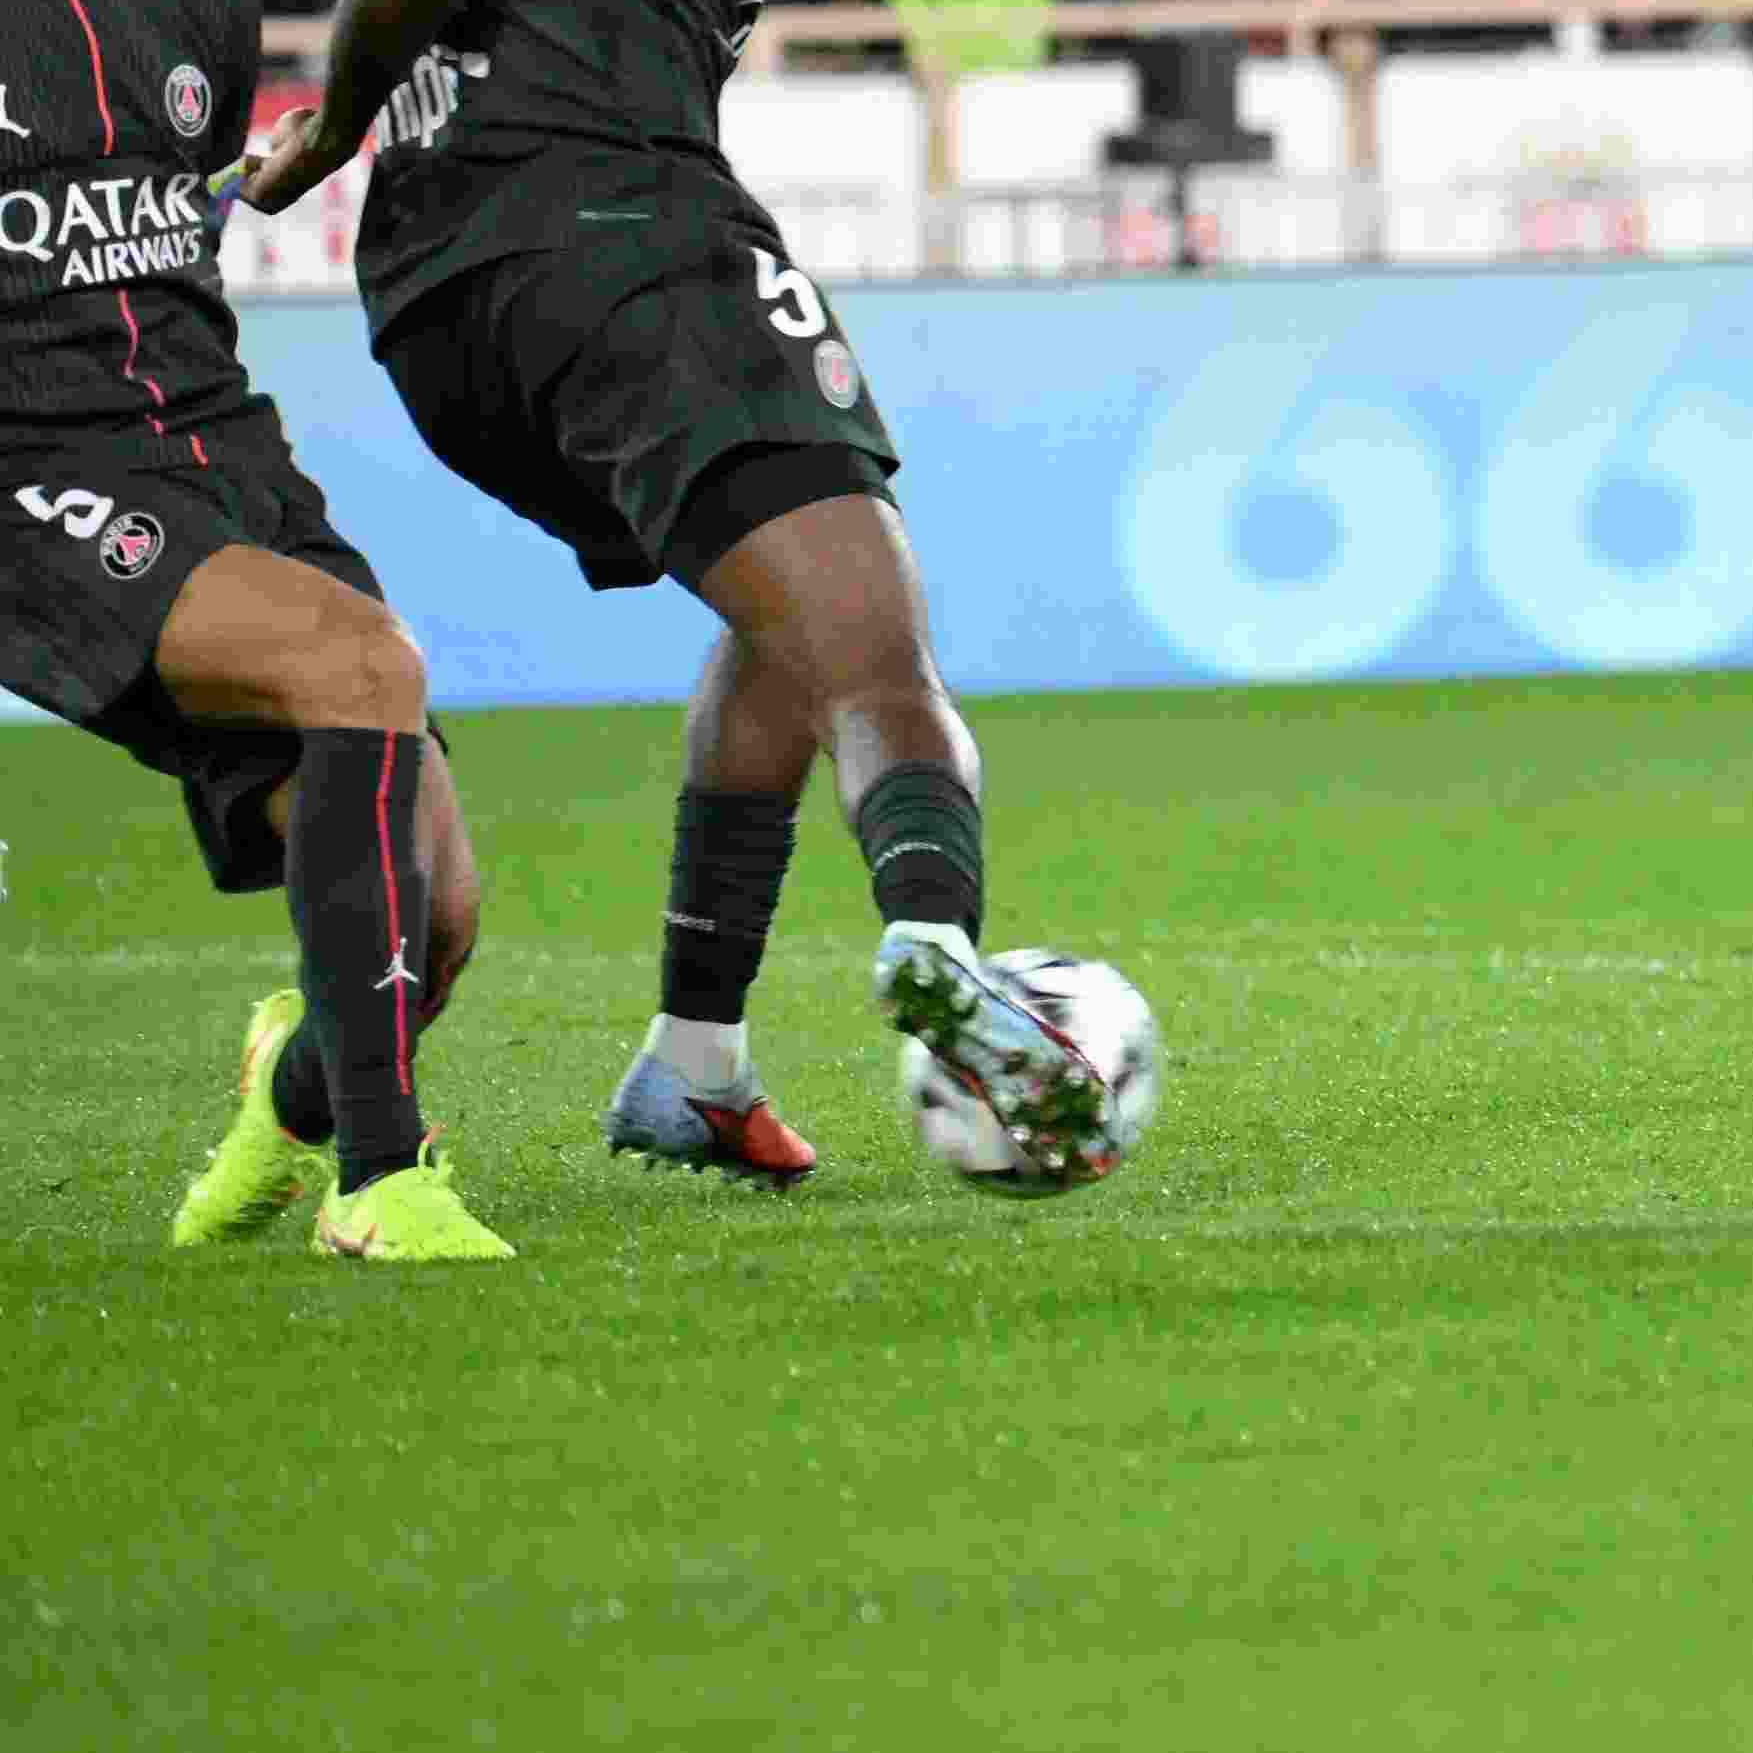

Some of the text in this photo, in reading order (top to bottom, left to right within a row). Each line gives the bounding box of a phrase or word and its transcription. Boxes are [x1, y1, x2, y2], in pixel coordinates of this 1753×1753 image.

[0, 173, 202, 262] QATAR
[61, 228, 203, 286] AIRWAYS
[750, 247, 825, 338] 5
[14, 485, 115, 539] 5
